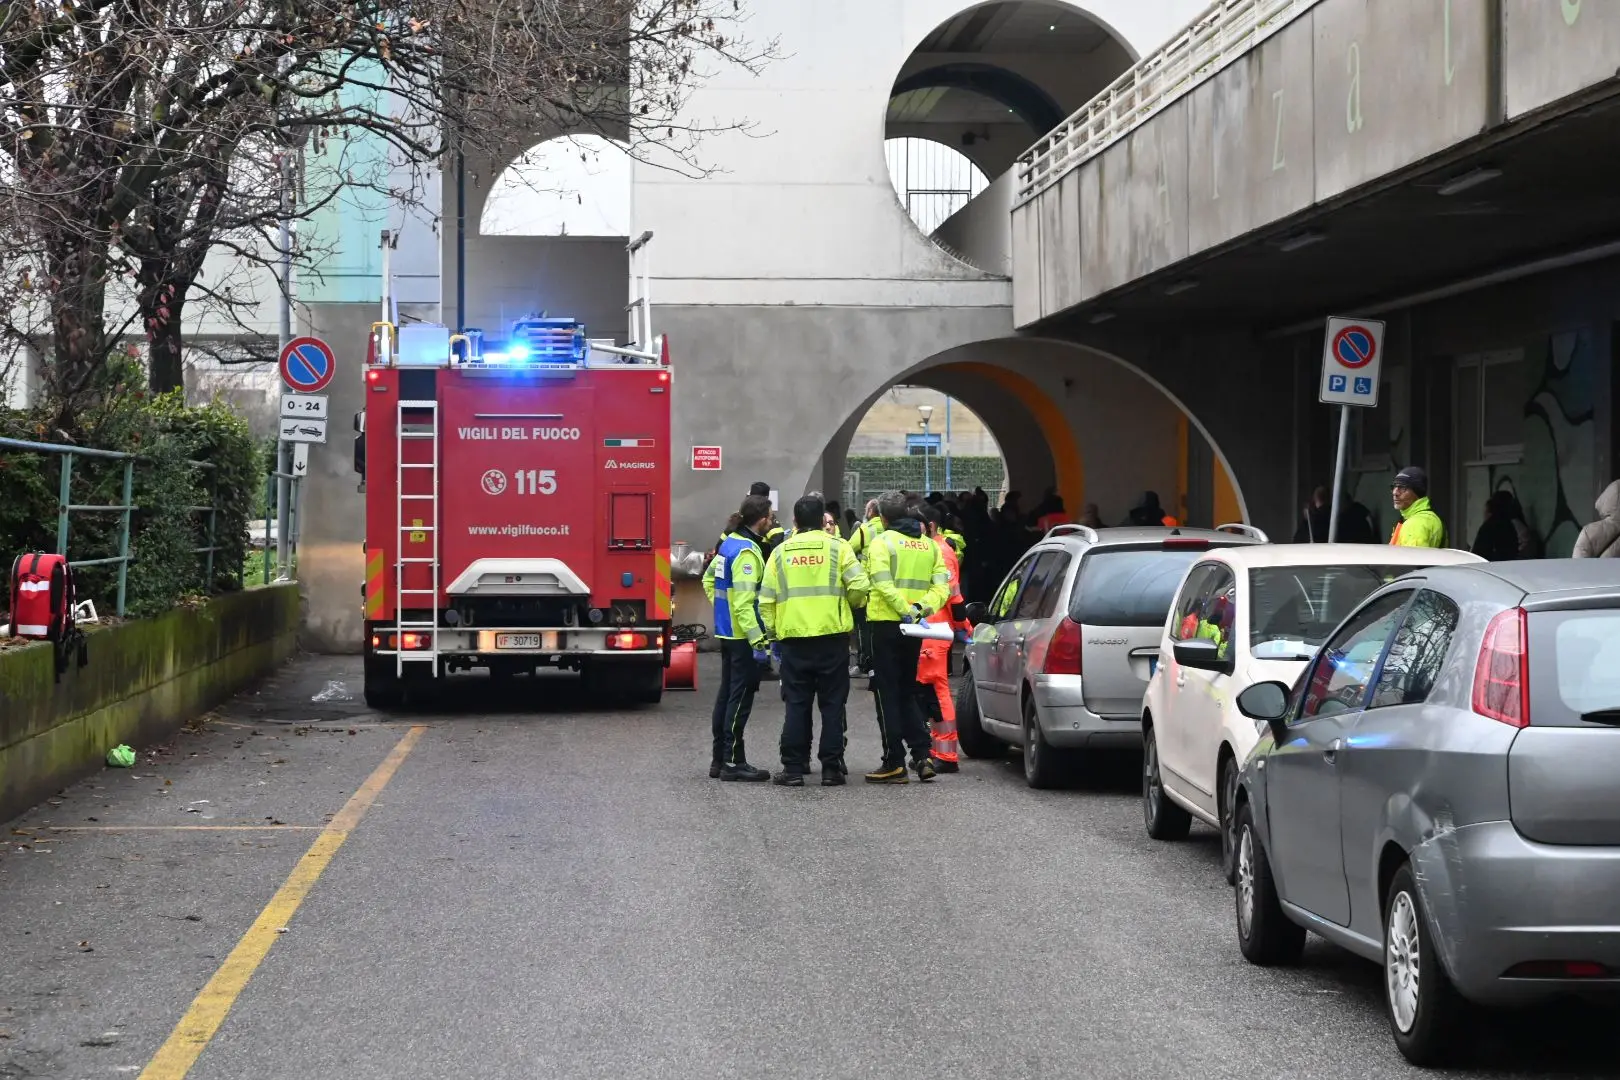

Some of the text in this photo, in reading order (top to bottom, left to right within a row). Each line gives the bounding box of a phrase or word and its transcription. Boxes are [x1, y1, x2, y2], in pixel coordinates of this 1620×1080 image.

[1332, 376, 1344, 390] P
[305, 402, 320, 410] 24
[458, 427, 581, 440] VIGILI DEL FUOCO
[514, 469, 558, 495] 115
[468, 524, 570, 537] www.vigilfuoco.it
[904, 539, 929, 551] AREU
[791, 555, 824, 566] AREU
[513, 636, 538, 646] 30719
